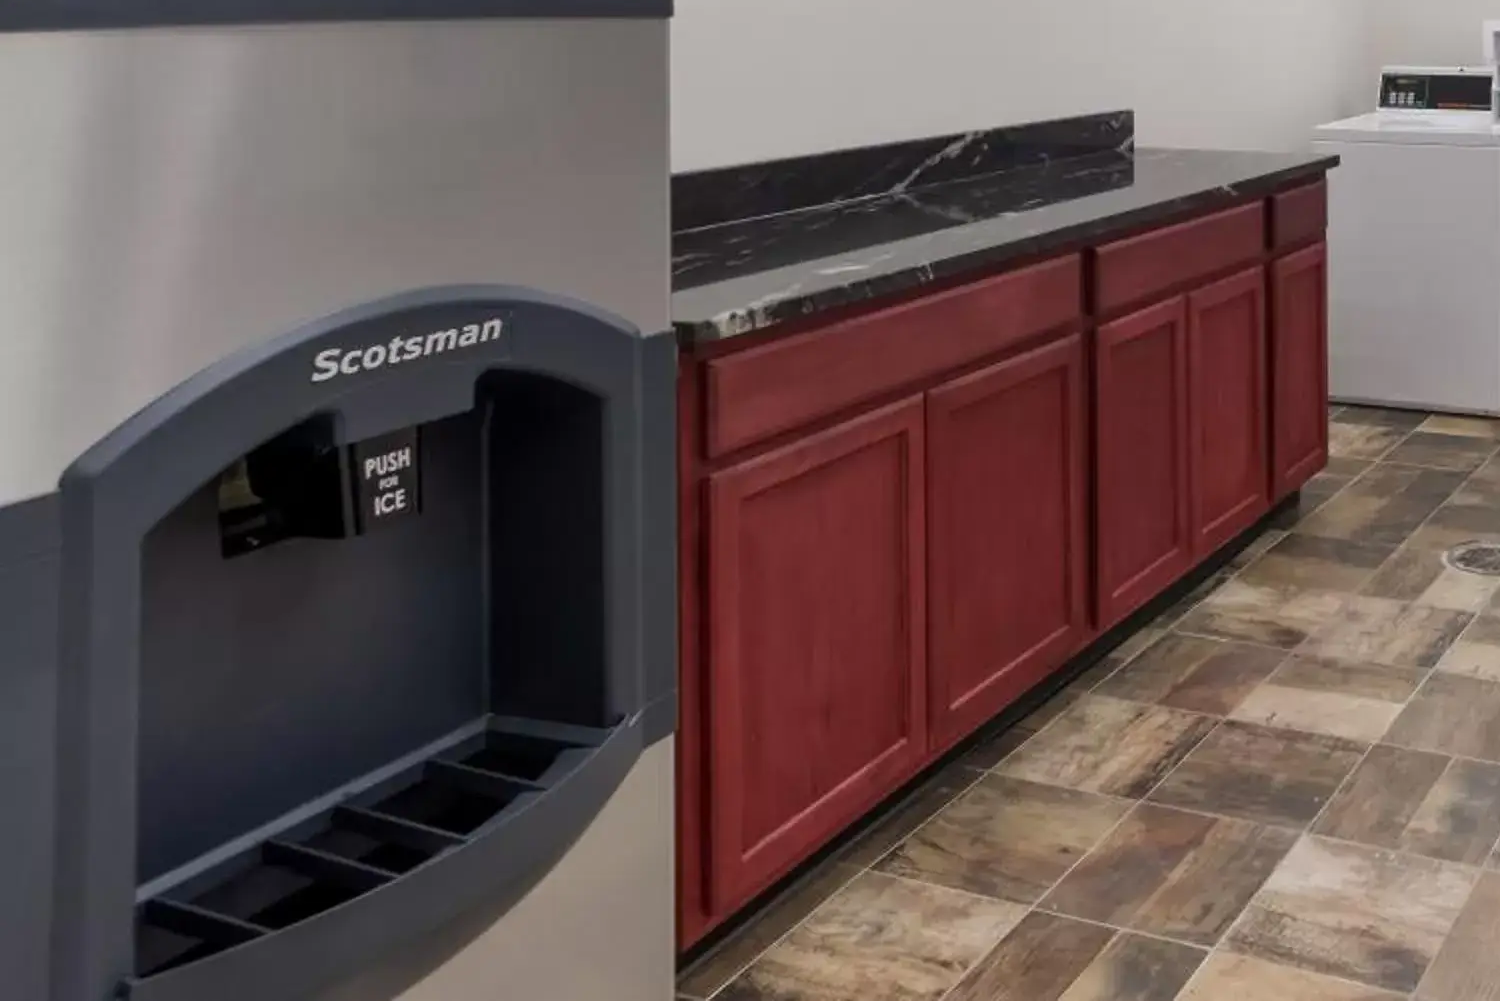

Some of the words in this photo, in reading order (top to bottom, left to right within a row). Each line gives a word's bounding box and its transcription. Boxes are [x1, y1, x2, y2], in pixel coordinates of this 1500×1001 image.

[311, 318, 502, 382] Scotsman
[364, 446, 411, 480] PUSH
[374, 488, 406, 516] ICE
